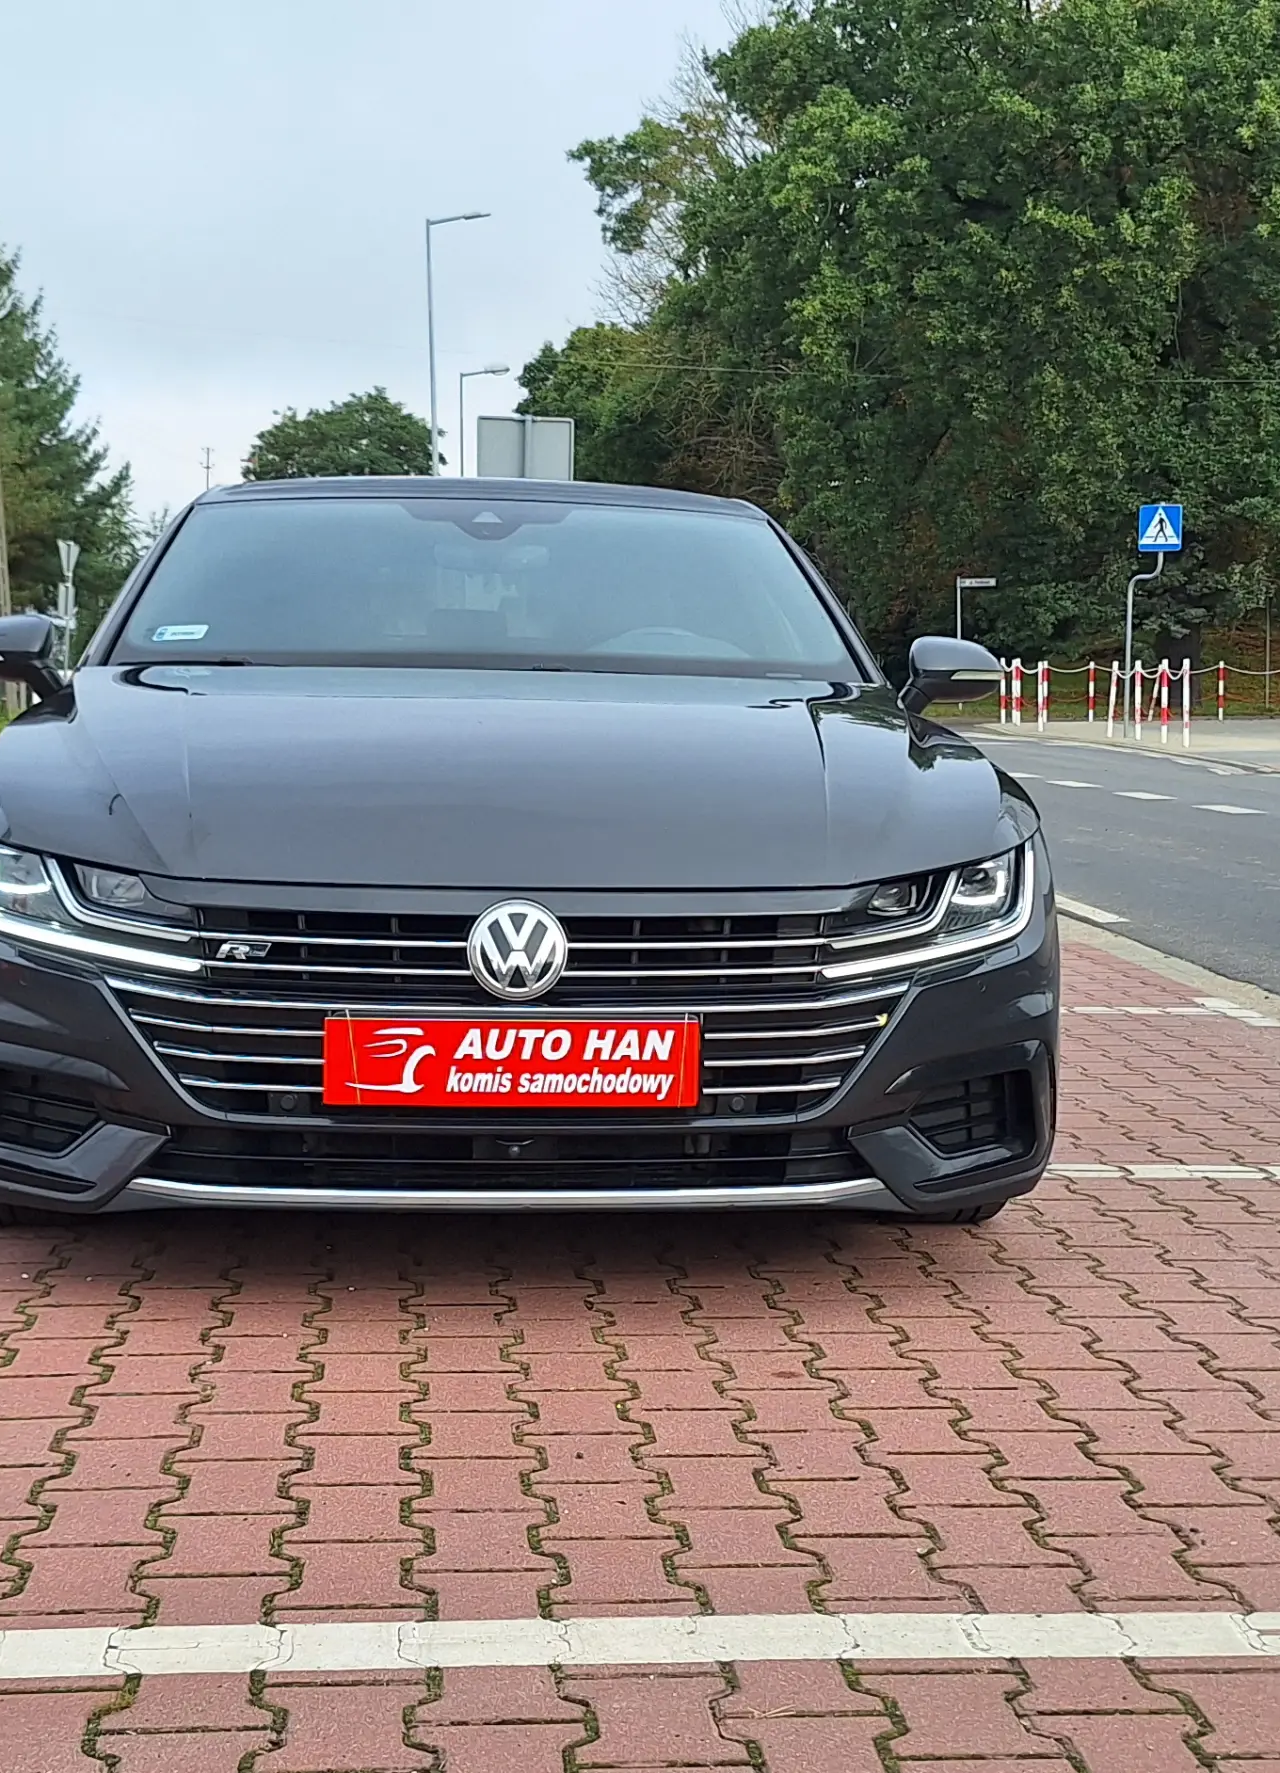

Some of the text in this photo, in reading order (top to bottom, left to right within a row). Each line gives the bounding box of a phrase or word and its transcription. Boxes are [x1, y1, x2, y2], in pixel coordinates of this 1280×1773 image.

[452, 1028, 676, 1062] AUTO HAN
[445, 1066, 675, 1101] komis samochodowy
